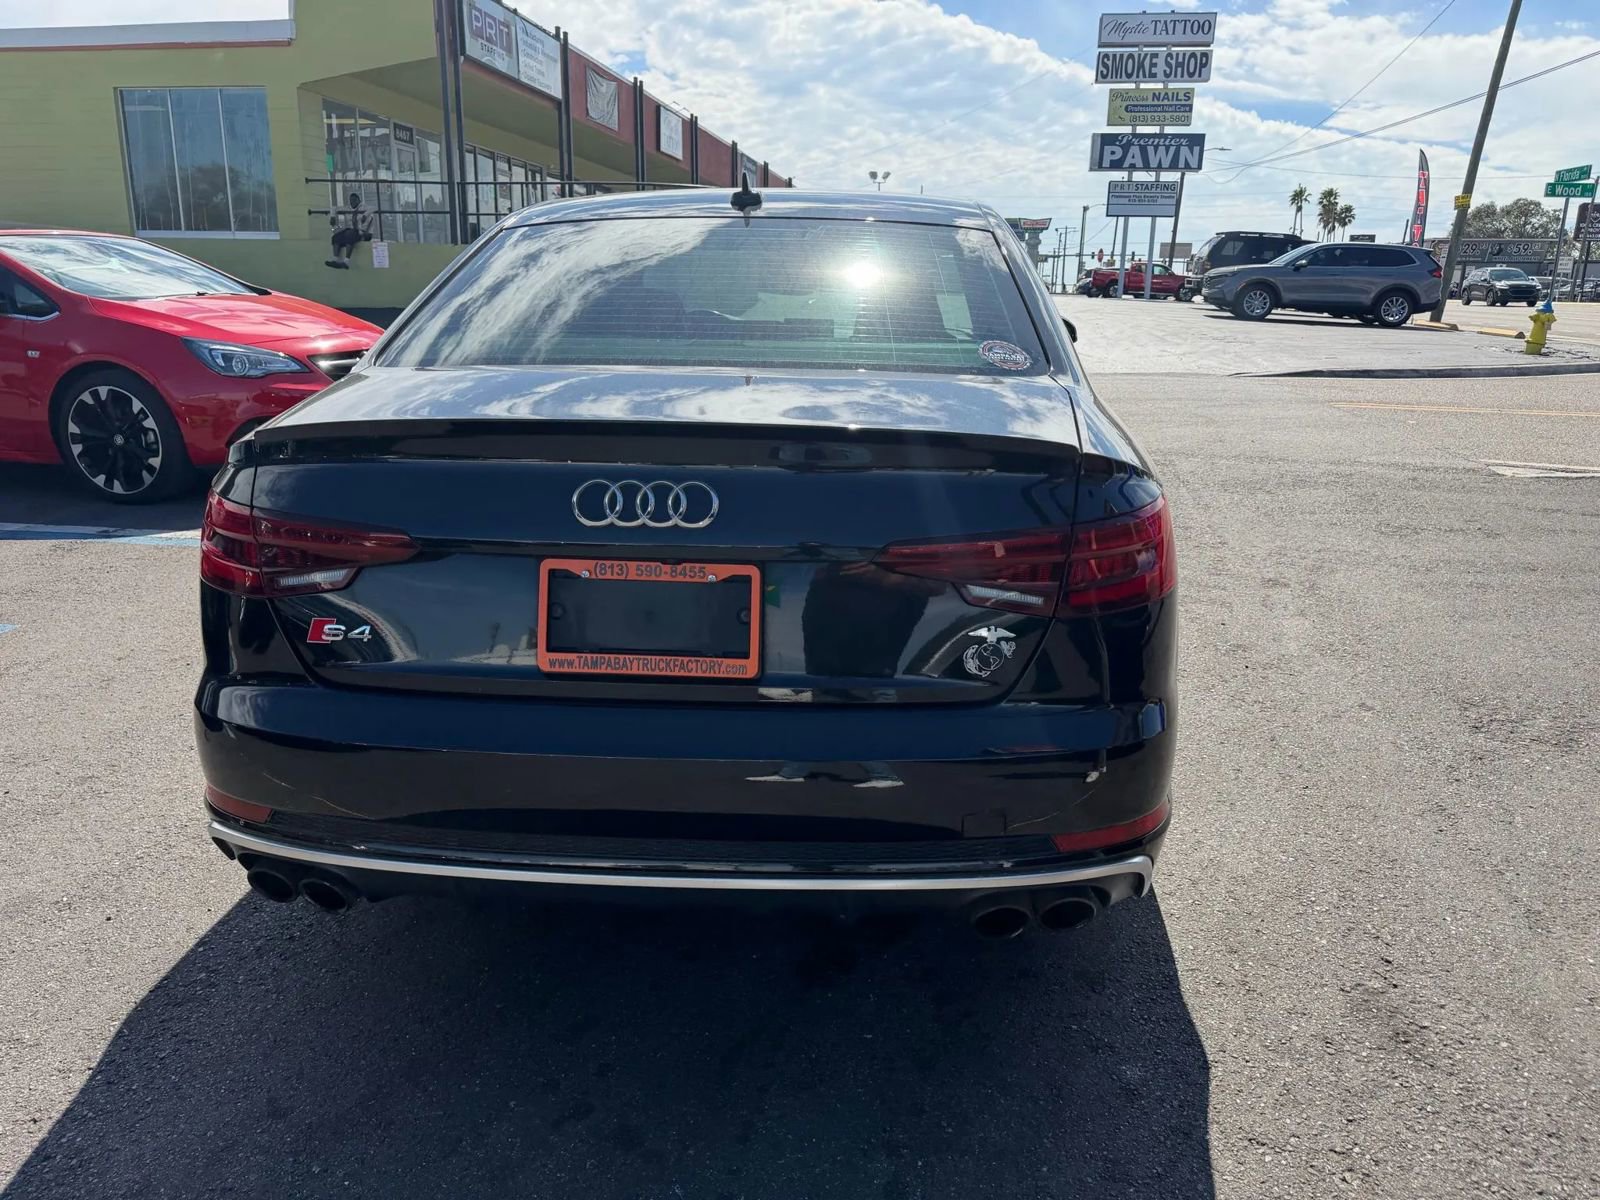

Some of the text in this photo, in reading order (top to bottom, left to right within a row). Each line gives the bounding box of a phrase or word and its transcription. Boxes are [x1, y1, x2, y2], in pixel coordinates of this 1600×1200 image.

[472, 8, 508, 47] PRT
[1103, 19, 1212, 40] Mystic TATTOO
[480, 41, 505, 61] STAFFG
[1100, 52, 1209, 79] SMOKE SHOP
[1112, 91, 1191, 103] Princess NAILS
[1129, 115, 1189, 123] (813) 933-5801
[1116, 134, 1189, 146] Premier
[1102, 145, 1200, 168] PAWN
[1560, 168, 1580, 182] Florida
[1134, 183, 1176, 192] STAFFING
[1547, 186, 1552, 194] E
[1555, 184, 1582, 196] Wood
[593, 561, 707, 579] (813) 590-8455
[321, 624, 372, 643] S4
[548, 655, 748, 676] www.TAMPABAYTRUCKFACTORY.com
